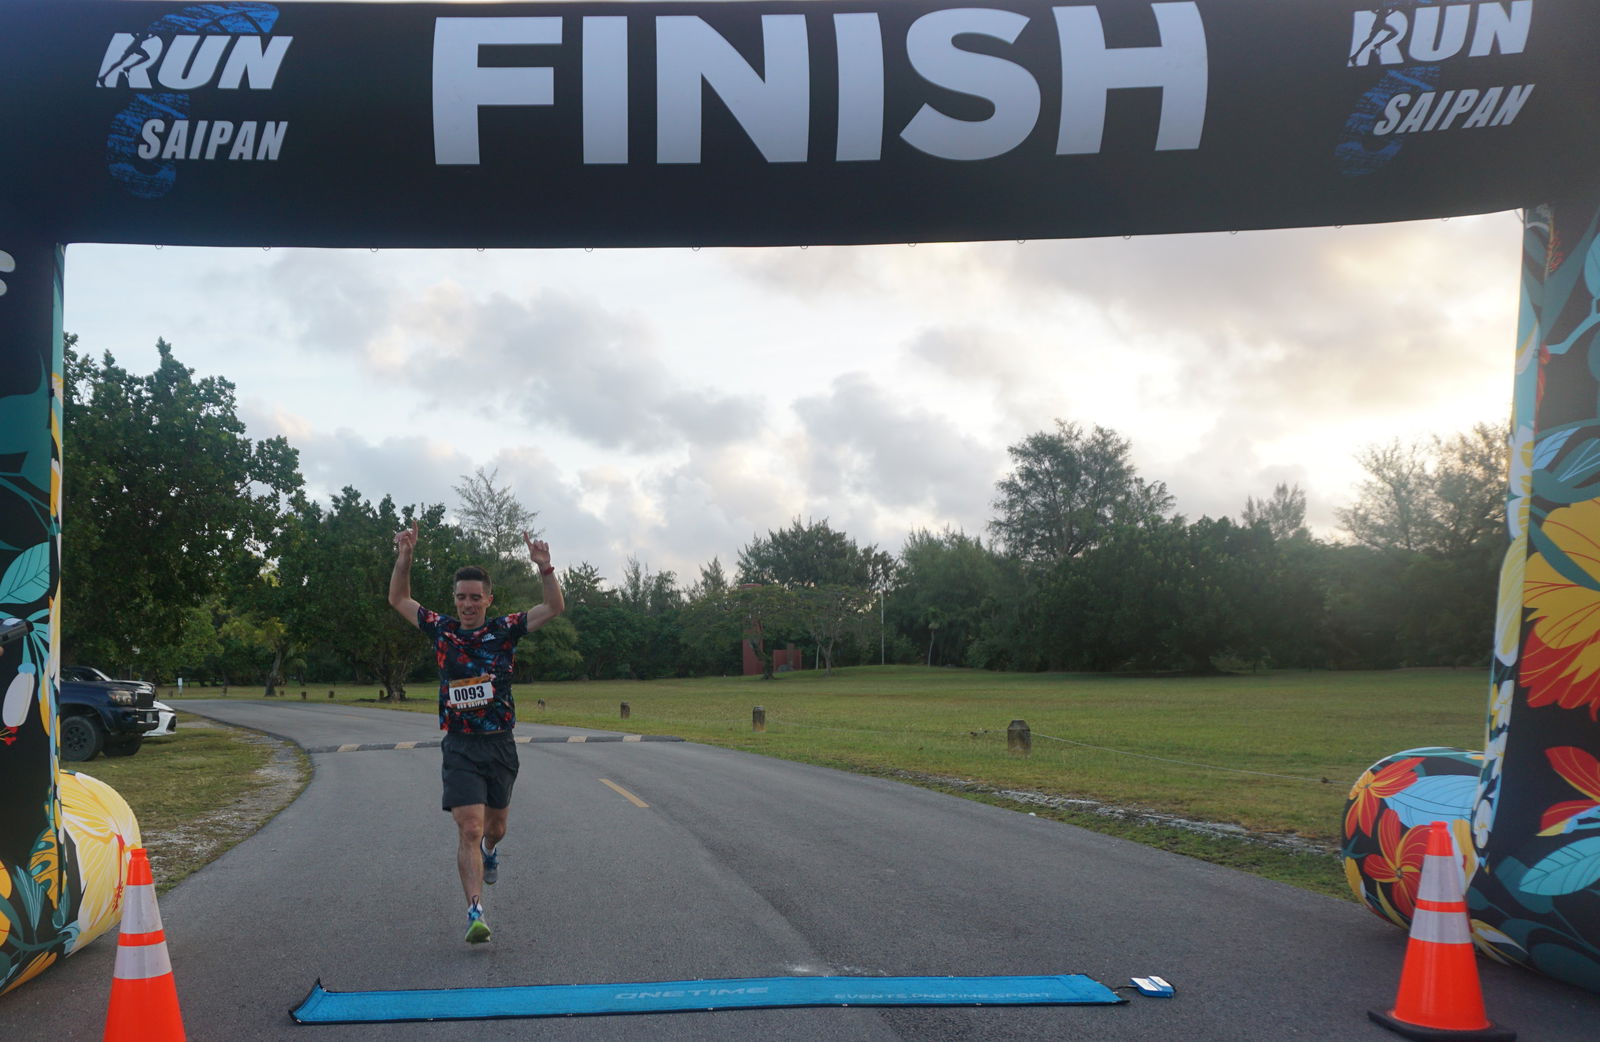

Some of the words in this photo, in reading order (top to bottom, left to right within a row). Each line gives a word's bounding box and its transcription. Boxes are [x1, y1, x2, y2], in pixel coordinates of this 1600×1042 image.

[1347, 0, 1533, 67] RUN
[96, 33, 294, 90] RUN
[432, 1, 1209, 165] FINISH
[1373, 84, 1536, 136] SAIPAN
[138, 118, 288, 161] SAIPAN
[454, 685, 485, 702] 0093
[615, 986, 769, 1000] ONETIME
